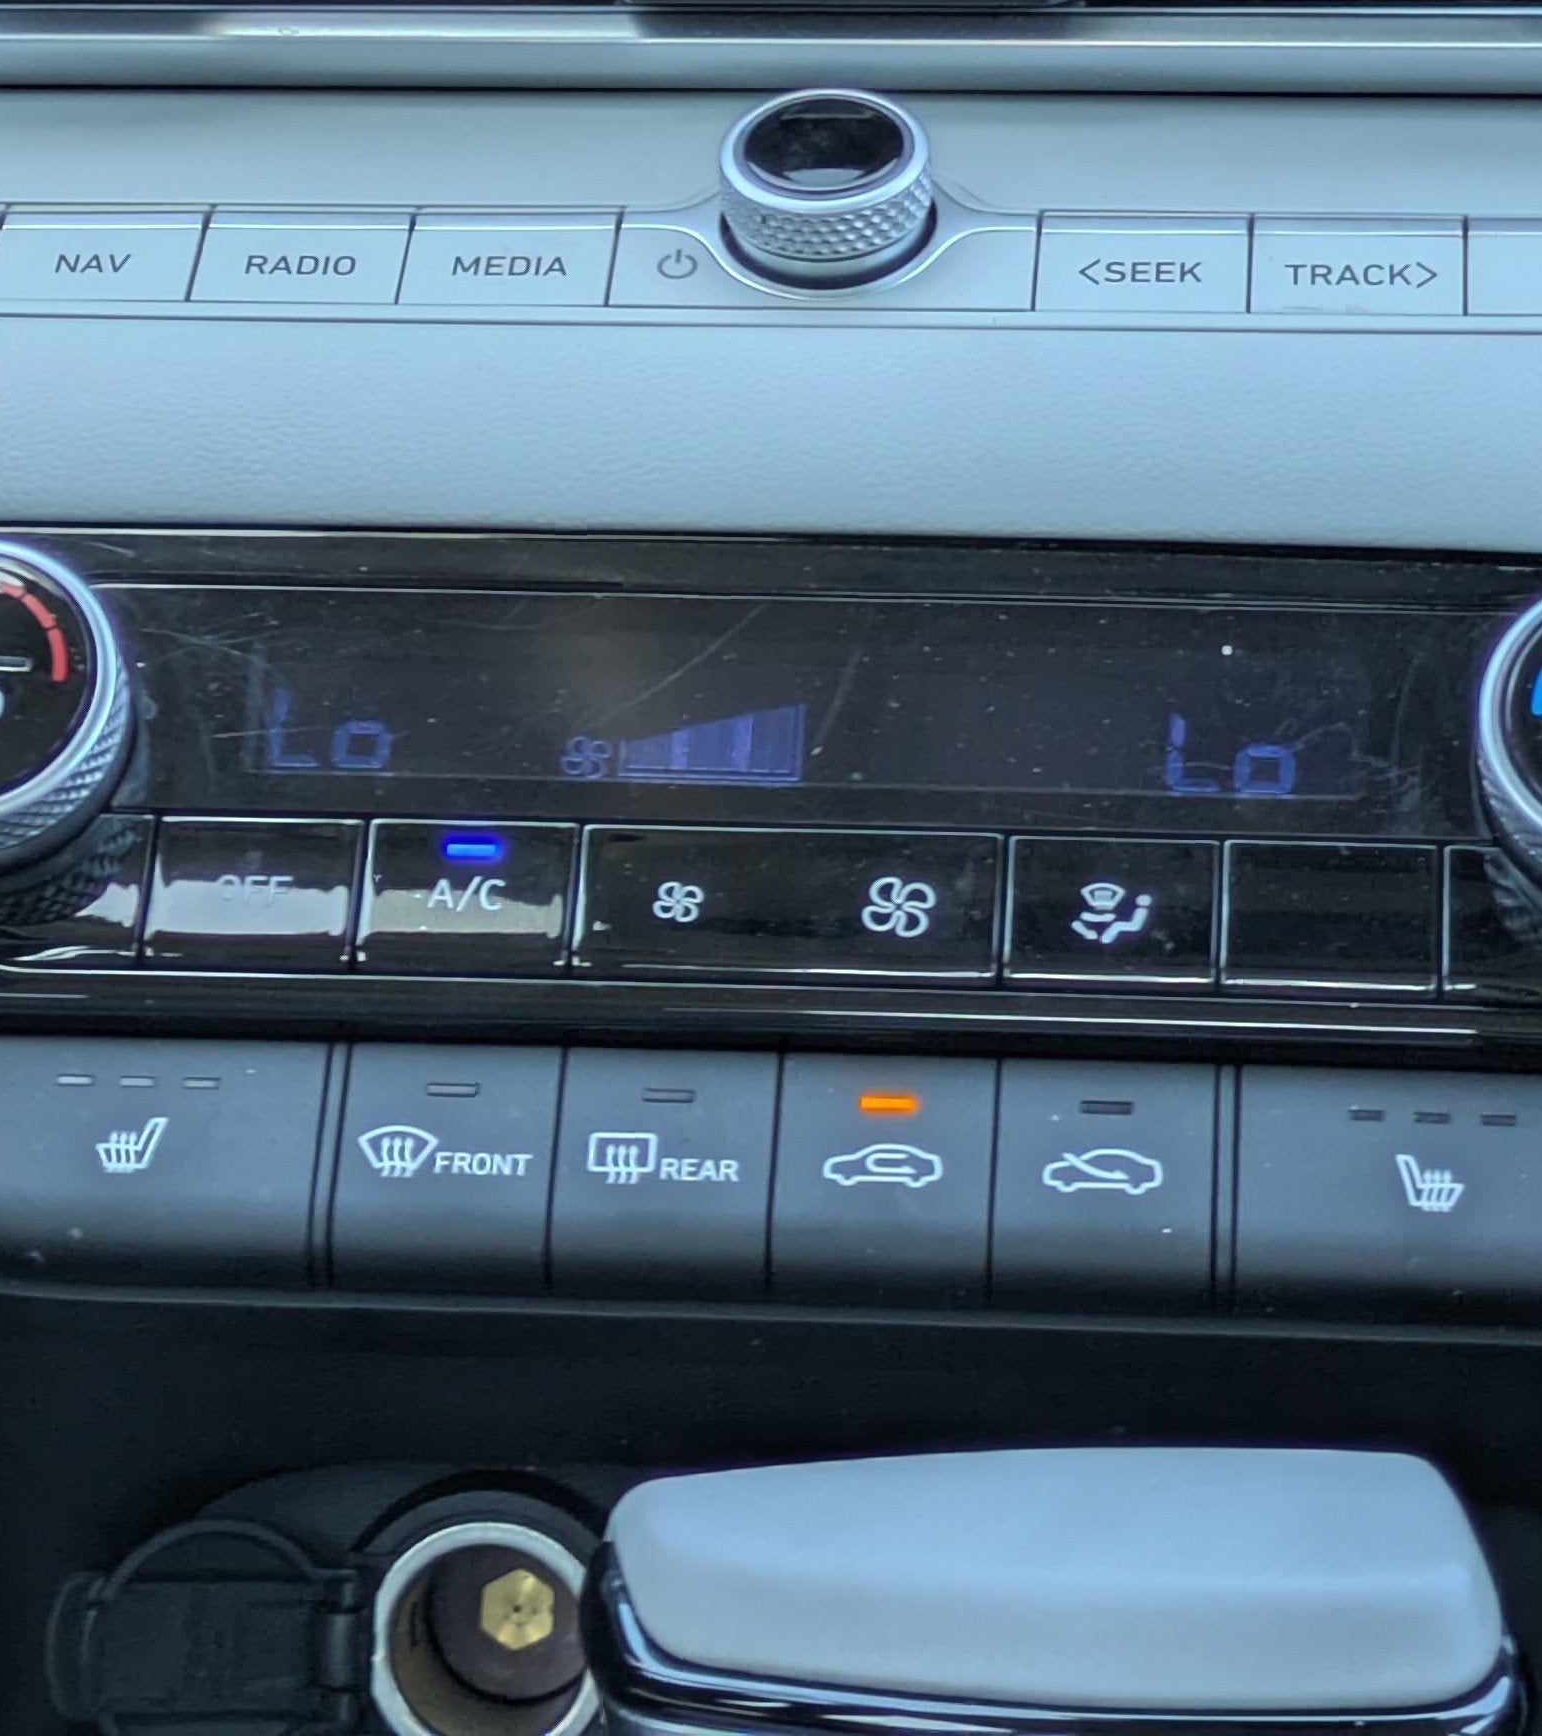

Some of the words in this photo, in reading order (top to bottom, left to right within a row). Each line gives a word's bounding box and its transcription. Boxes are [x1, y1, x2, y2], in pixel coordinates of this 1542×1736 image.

[54, 253, 132, 274] NAV
[244, 254, 357, 276] RADIO
[451, 255, 568, 277] MEDIA
[426, 875, 507, 913] A/C
[433, 1151, 534, 1177] FRONT
[659, 1157, 740, 1183] REAR
